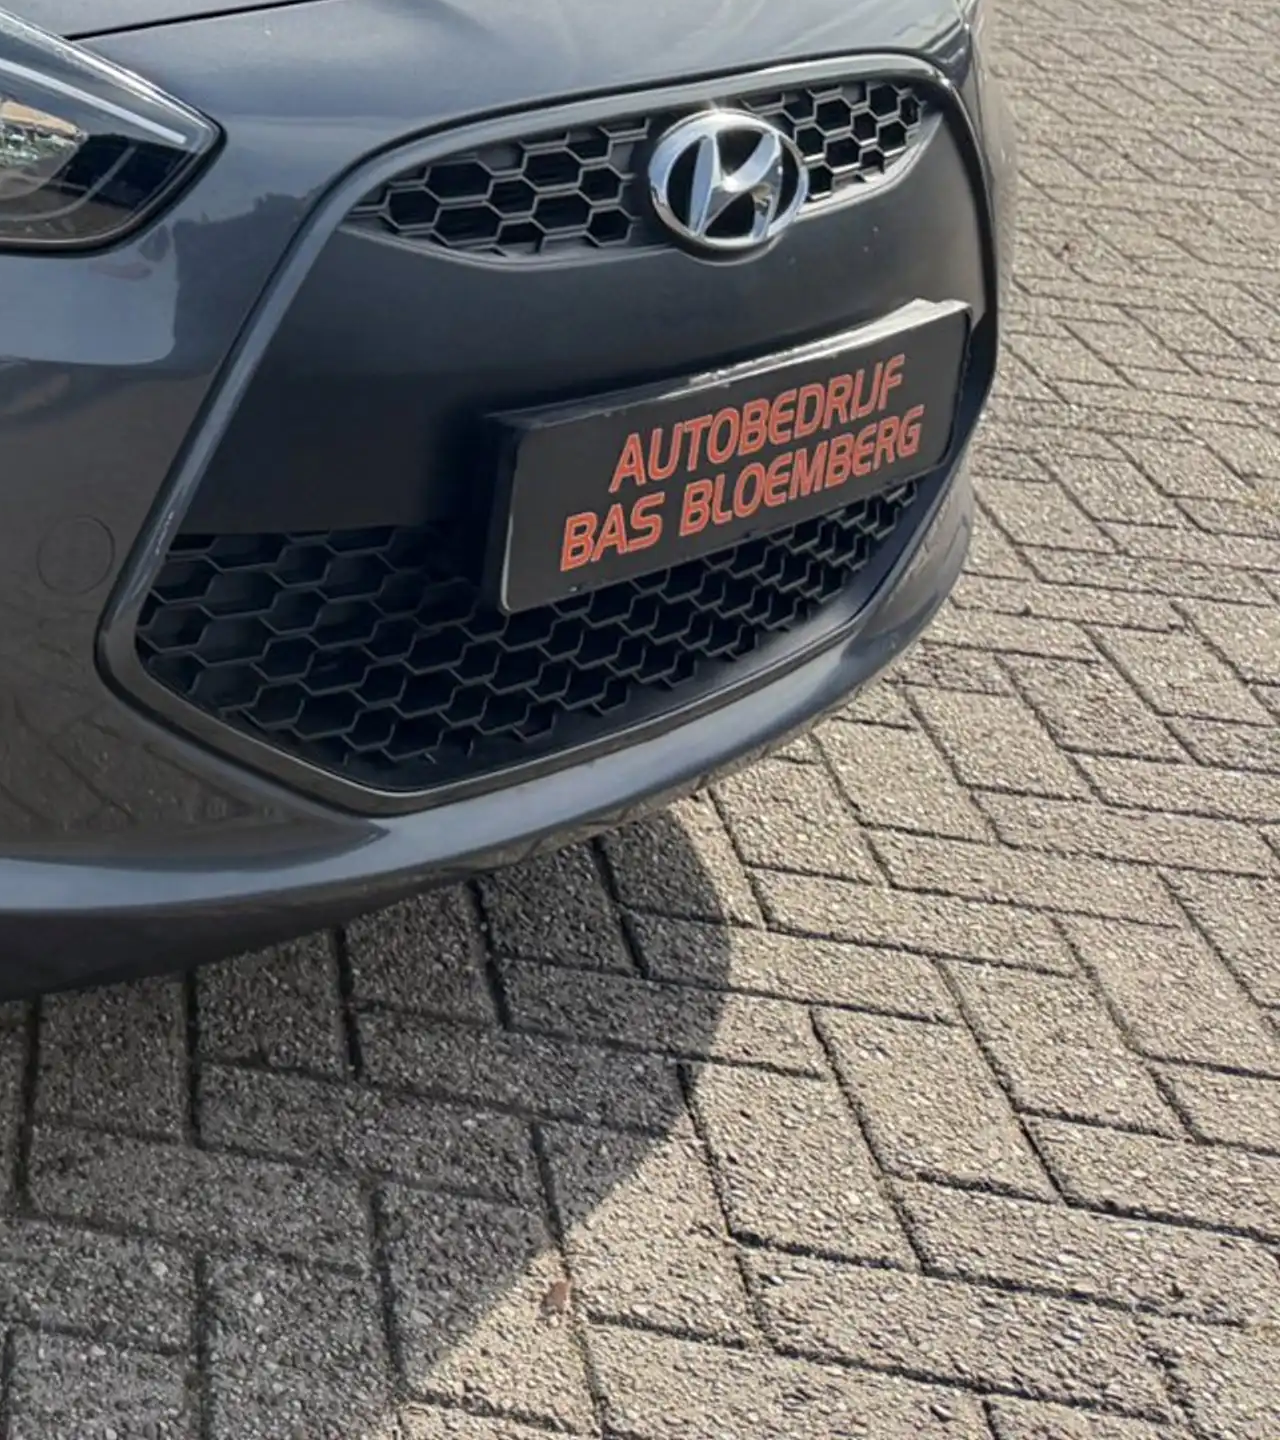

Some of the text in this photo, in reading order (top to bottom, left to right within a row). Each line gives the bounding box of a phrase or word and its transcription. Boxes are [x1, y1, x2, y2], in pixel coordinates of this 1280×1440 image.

[560, 405, 925, 572] BAS BLOEMBERG
[609, 354, 905, 493] AUTOBEDRIJF
